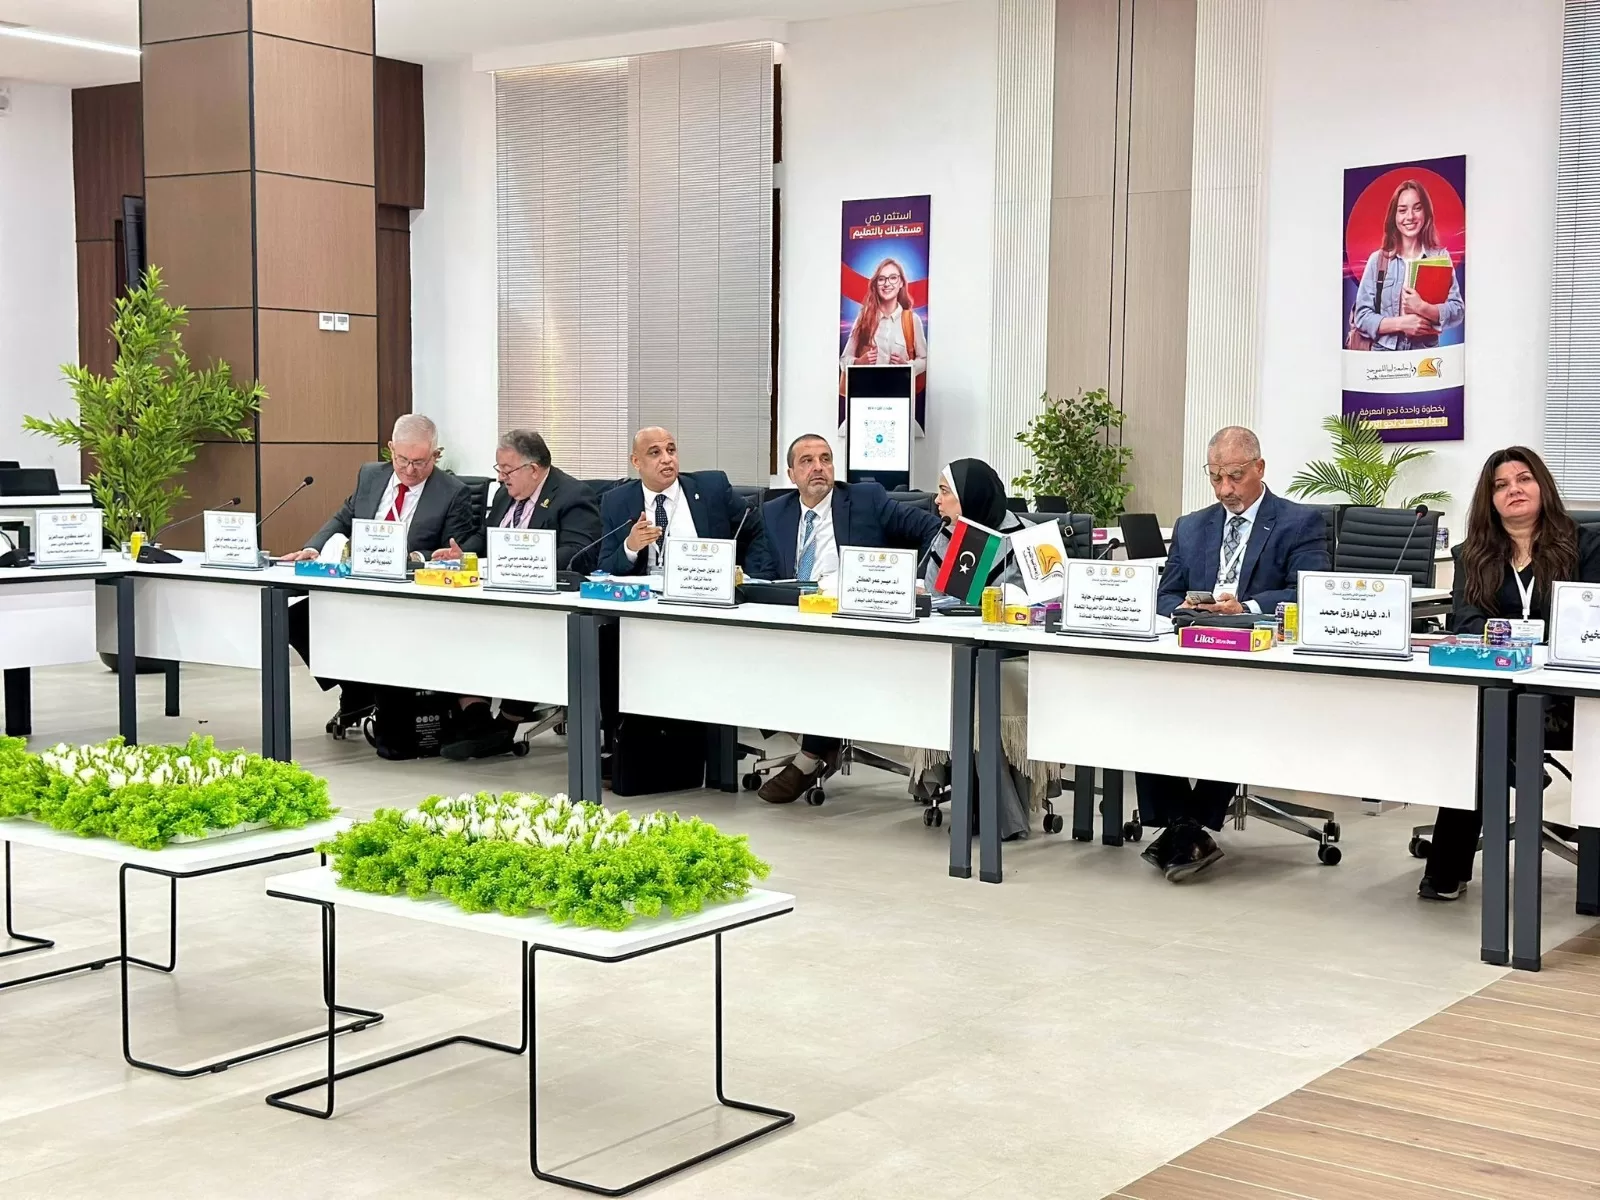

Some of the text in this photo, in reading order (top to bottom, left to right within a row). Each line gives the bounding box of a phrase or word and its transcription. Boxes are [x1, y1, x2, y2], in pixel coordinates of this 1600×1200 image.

[865, 210, 912, 226] استثمر في
[853, 225, 922, 240] مستقبلك بالتعليم
[1360, 405, 1445, 417] بخطوة واحدة نحو المعرفة
[1340, 608, 1360, 618] فاروق
[1361, 610, 1377, 620] فيان
[1324, 626, 1381, 638] الجمهورية العراقية
[1194, 634, 1215, 644] Lilas
